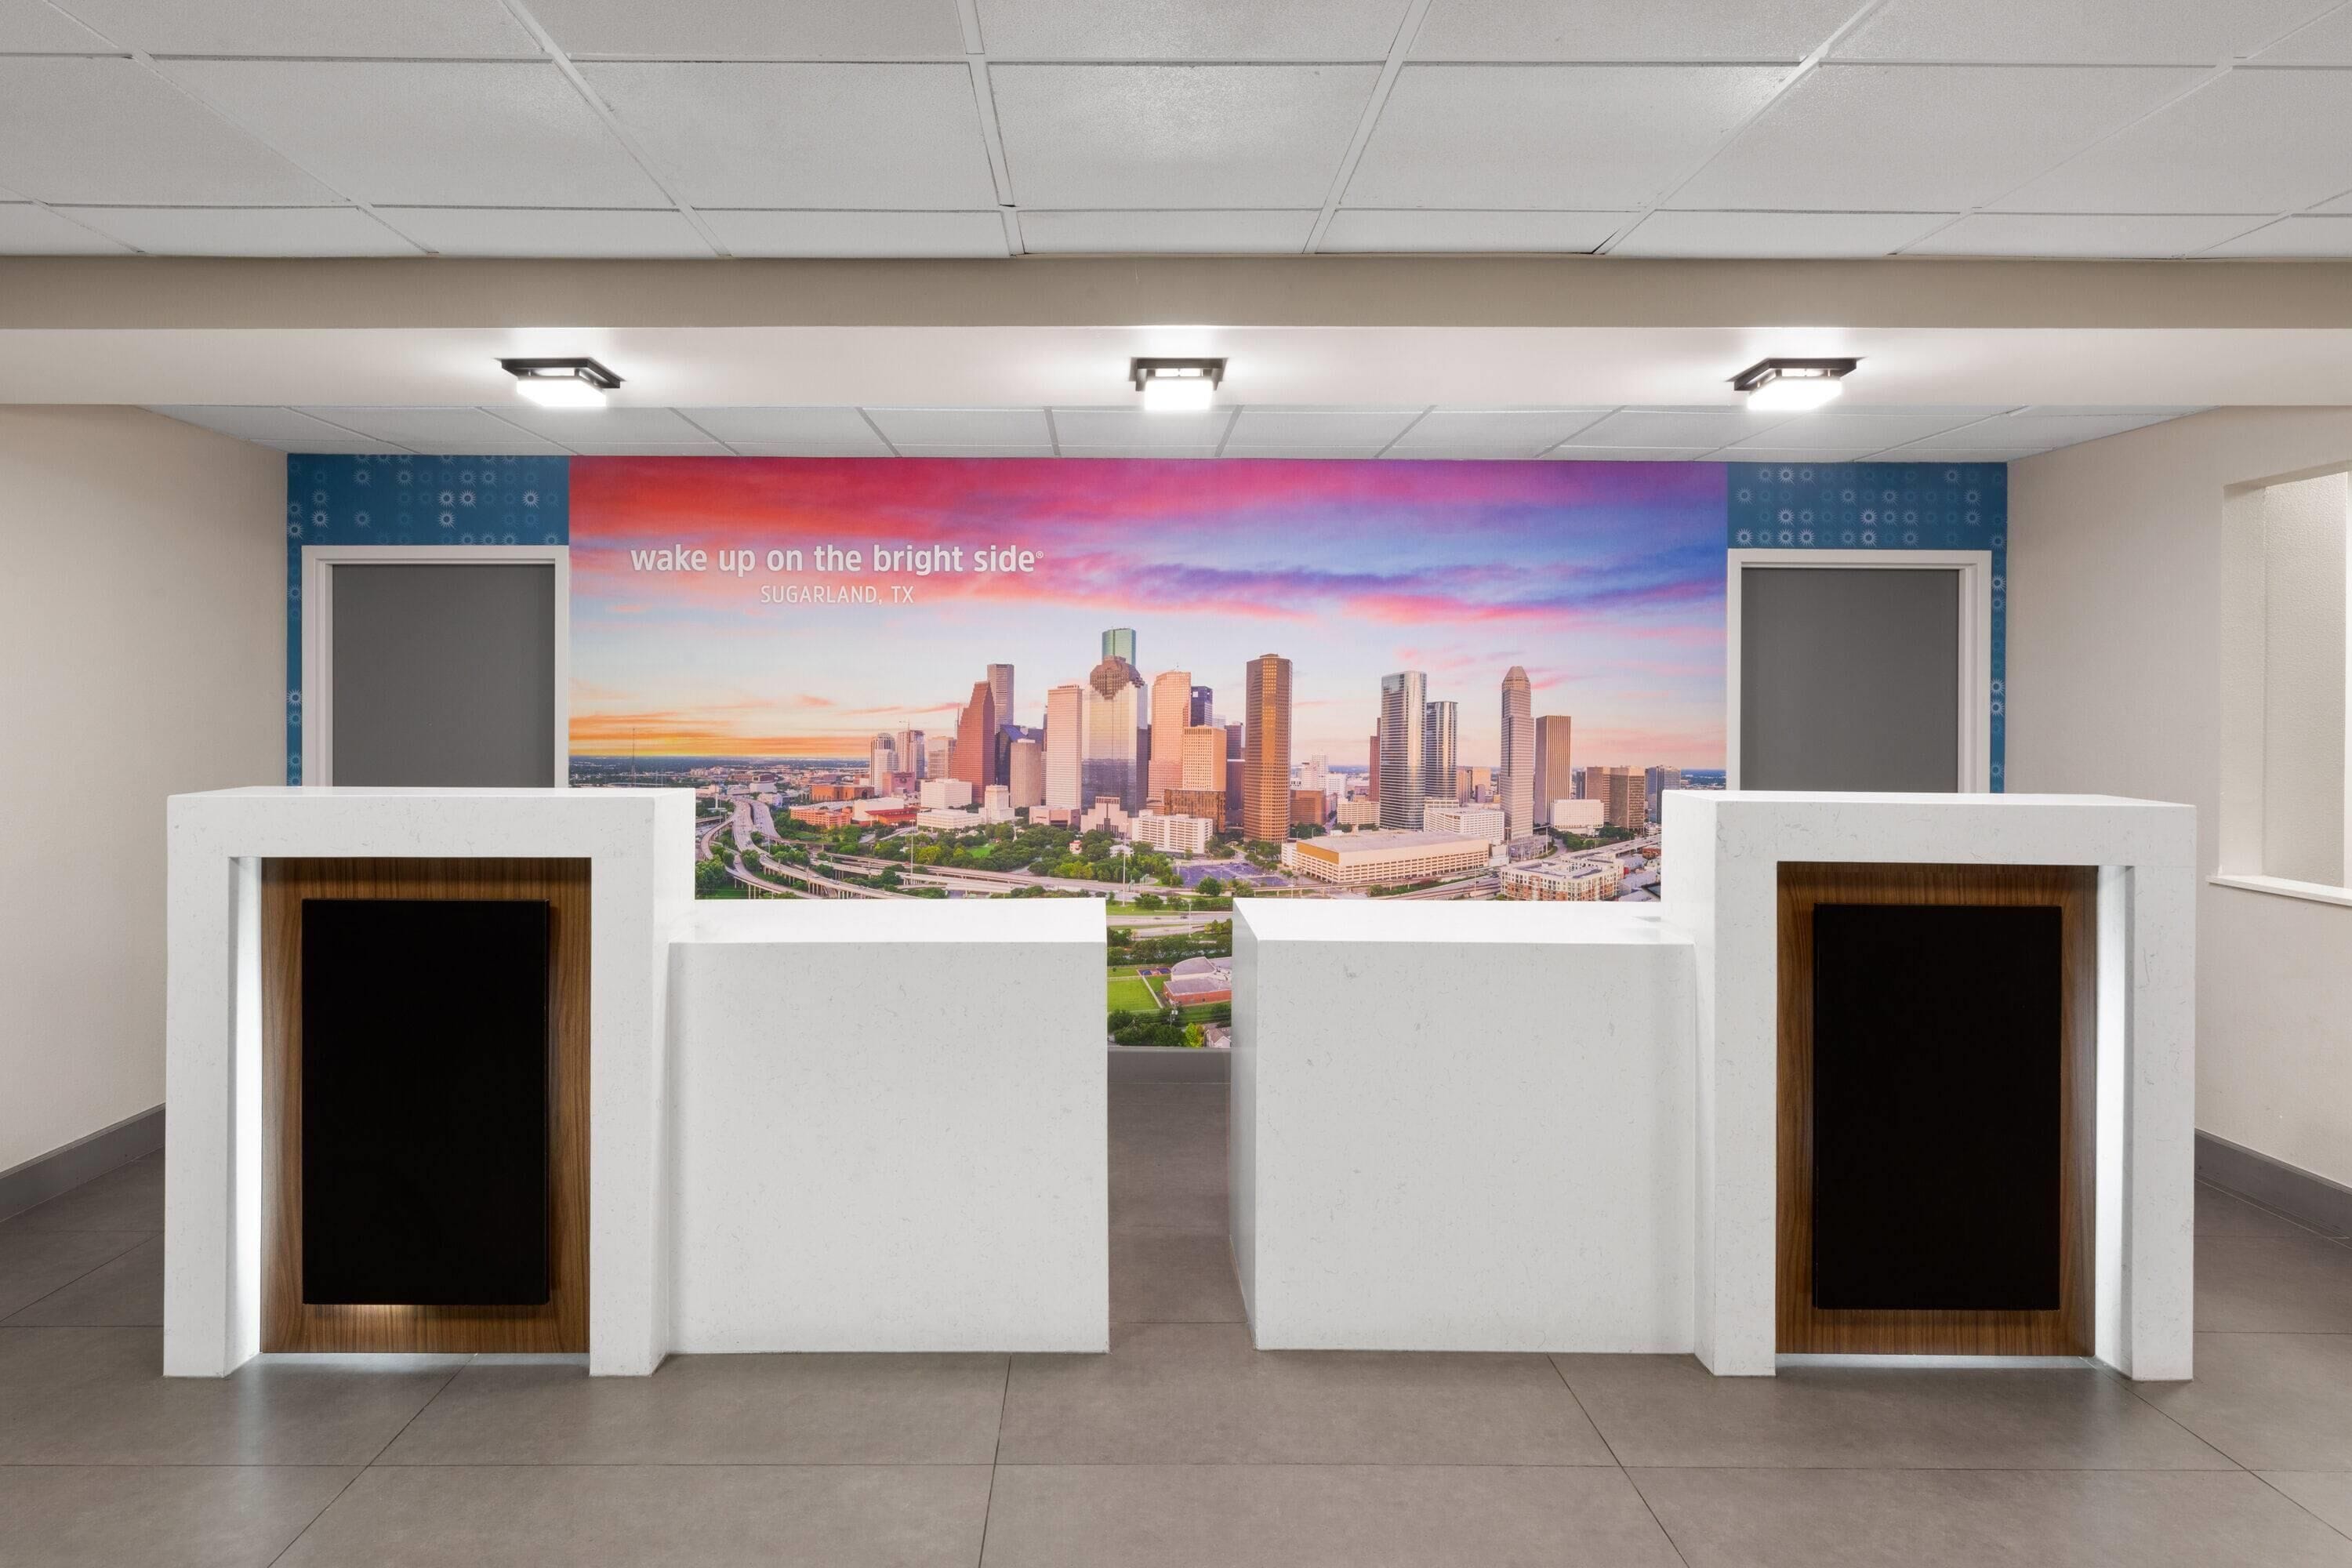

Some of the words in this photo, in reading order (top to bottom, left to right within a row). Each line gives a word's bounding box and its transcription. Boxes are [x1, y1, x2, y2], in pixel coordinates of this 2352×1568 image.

[631, 545, 706, 572] wake
[719, 550, 755, 577] up
[767, 550, 803, 572] on
[814, 545, 862, 572] the
[873, 545, 963, 575] bright
[760, 586, 882, 604] SUGARLAND,
[891, 586, 913, 604] TX
